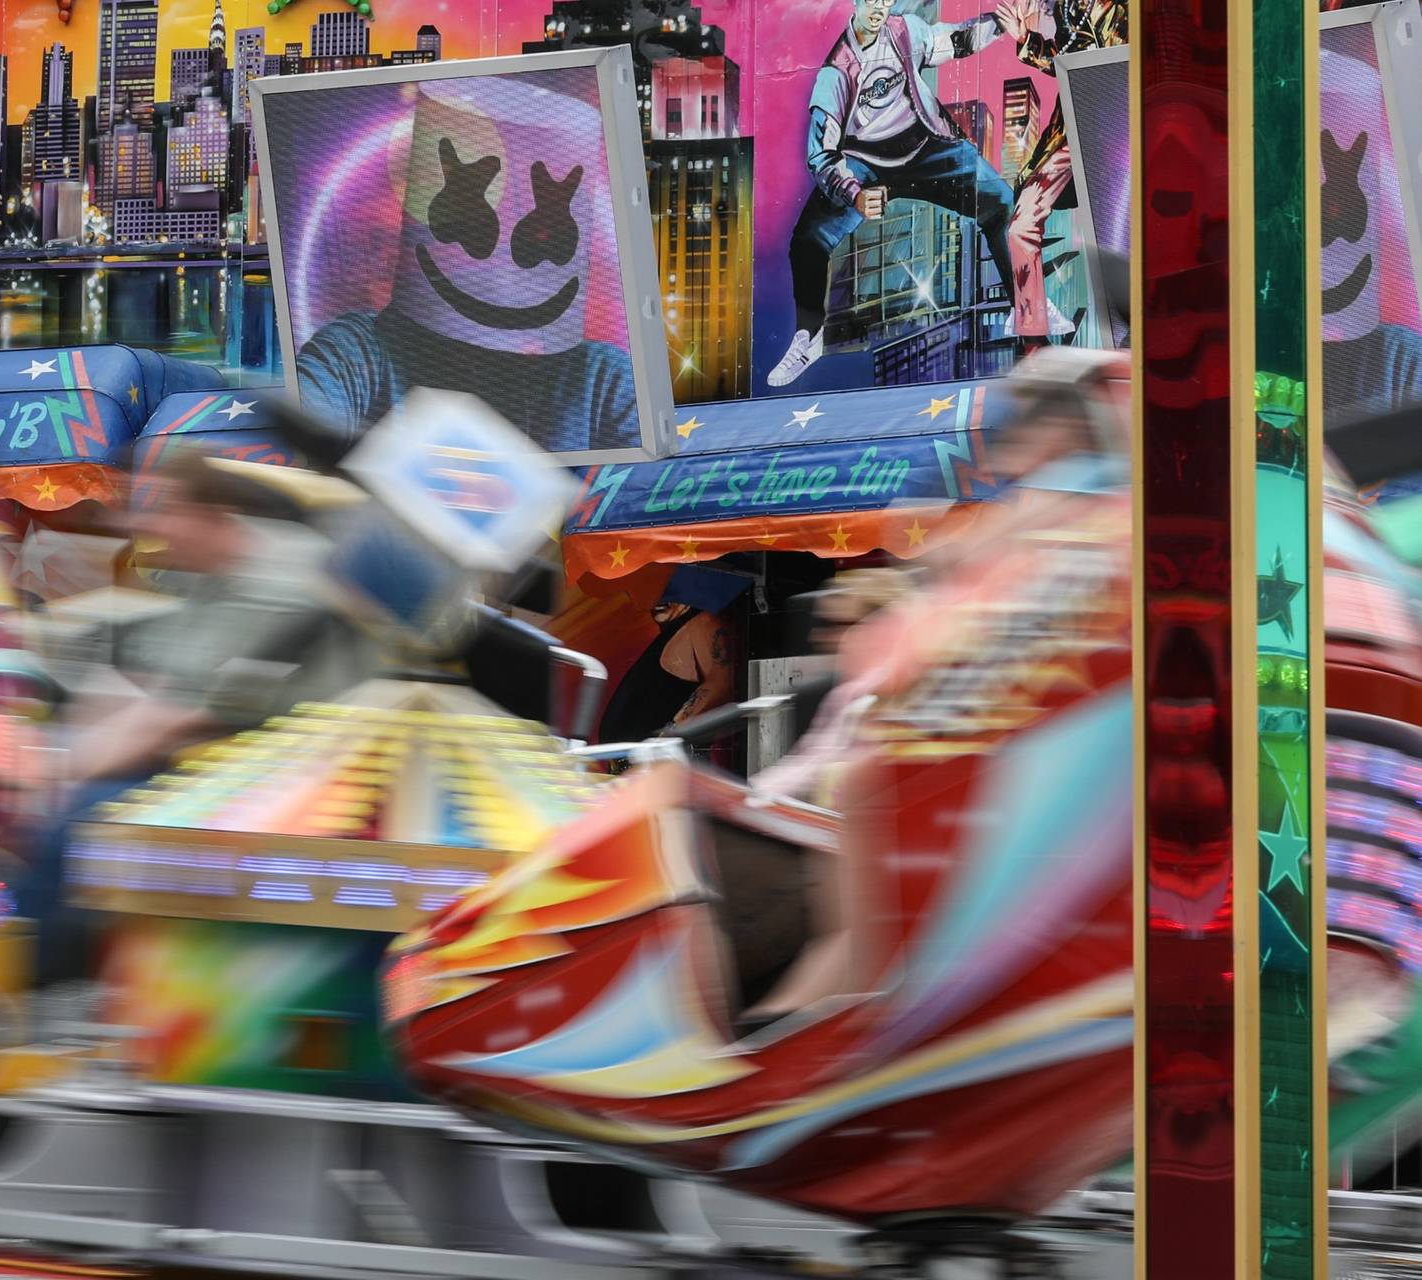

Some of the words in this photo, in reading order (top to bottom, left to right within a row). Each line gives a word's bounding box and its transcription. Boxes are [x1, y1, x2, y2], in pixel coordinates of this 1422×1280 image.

[644, 456, 750, 513] Let's
[751, 452, 837, 505] have
[843, 445, 911, 497] fun
